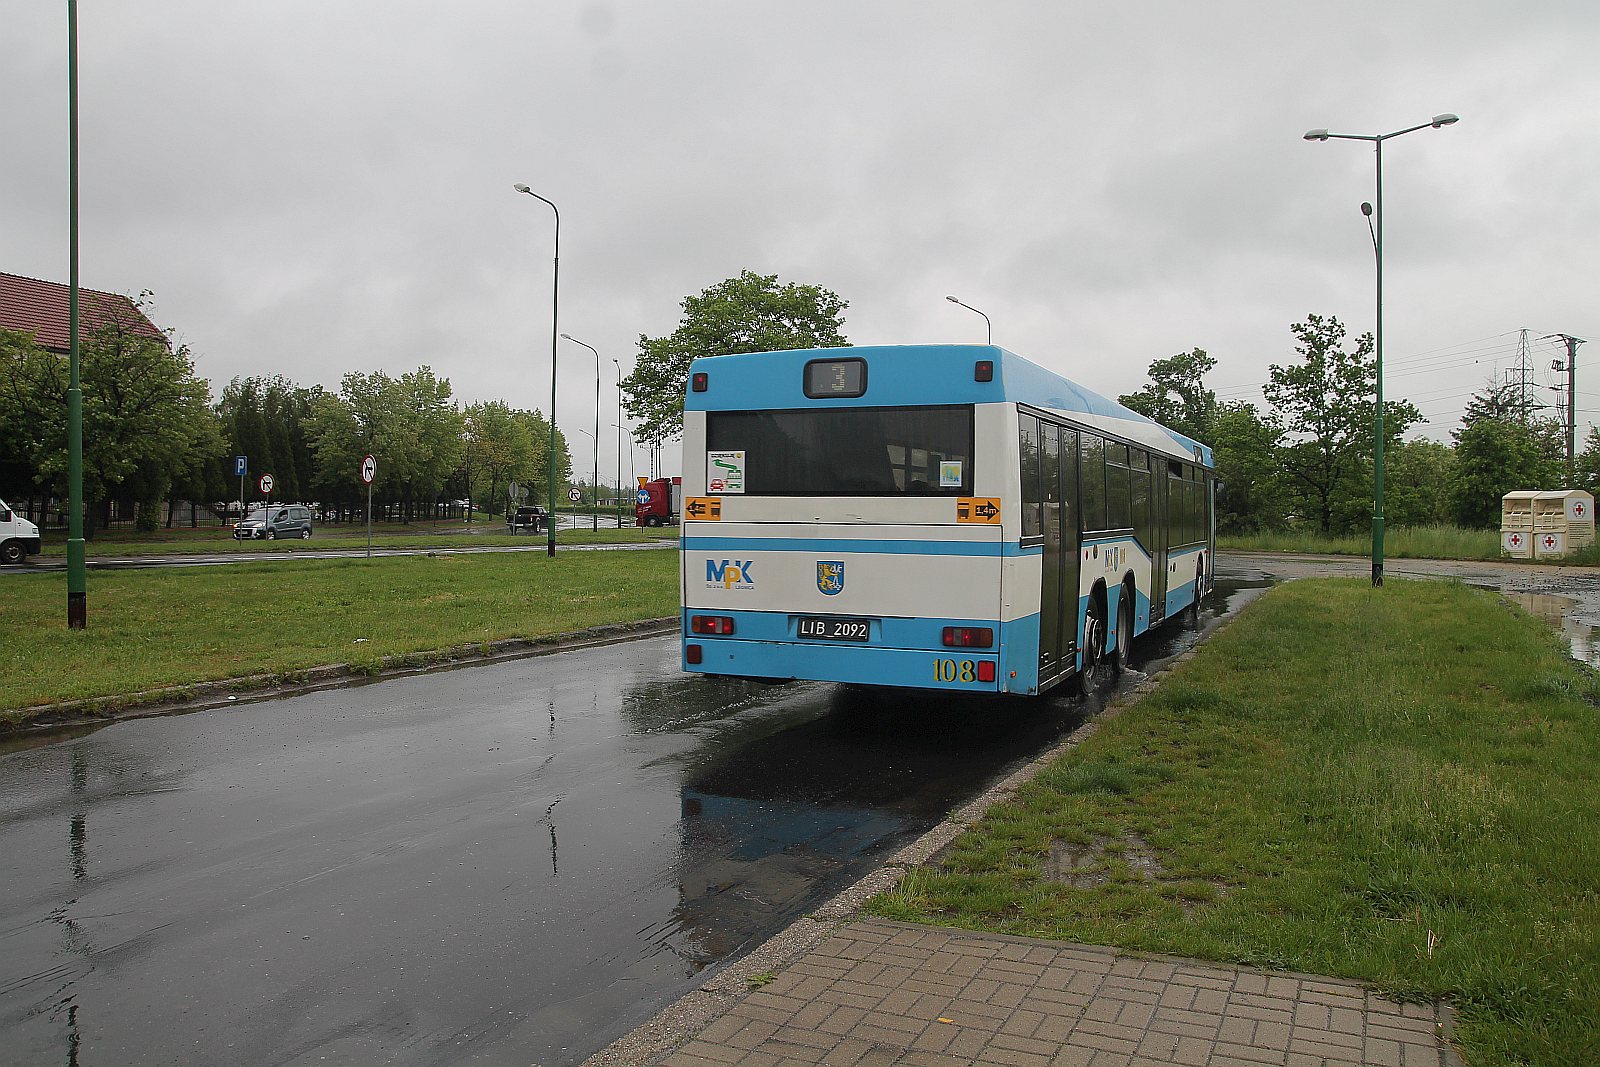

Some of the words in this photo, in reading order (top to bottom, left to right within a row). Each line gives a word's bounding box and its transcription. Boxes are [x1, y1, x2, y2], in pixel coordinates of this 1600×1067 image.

[832, 364, 846, 391] 3
[238, 458, 245, 473] P
[801, 621, 826, 635] LIB
[833, 623, 867, 637] 2092
[932, 658, 977, 683] 108
